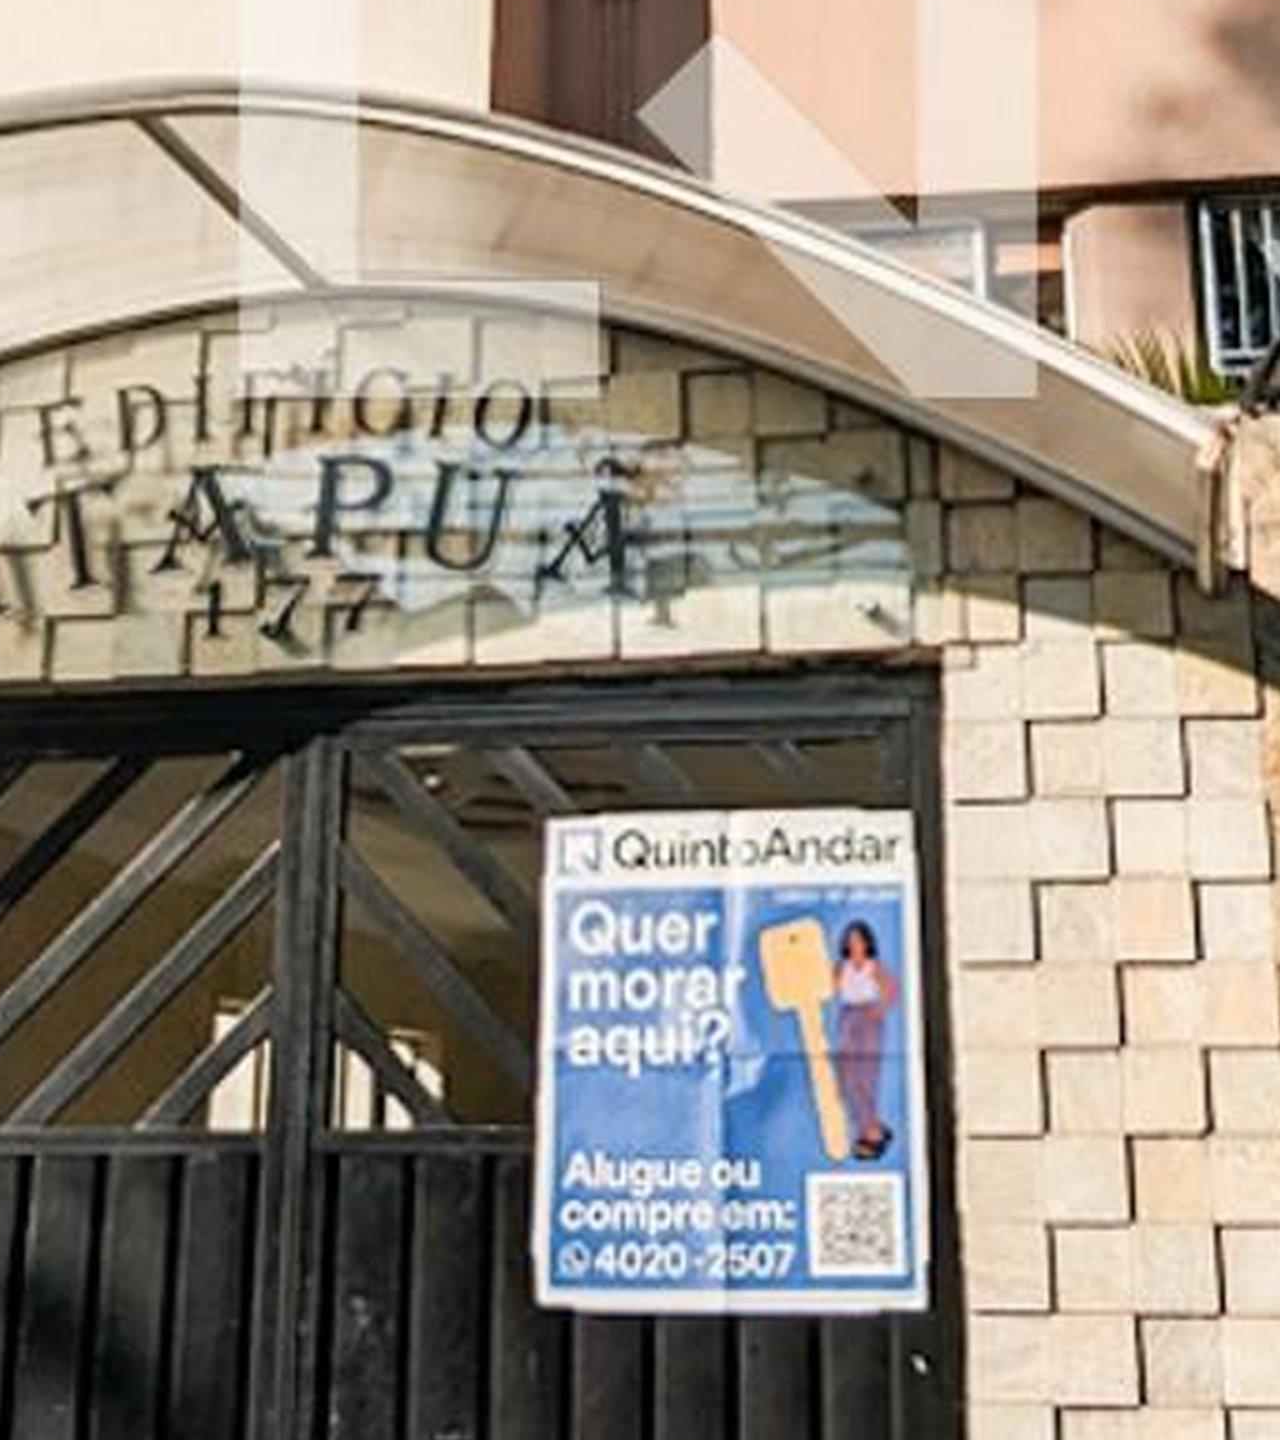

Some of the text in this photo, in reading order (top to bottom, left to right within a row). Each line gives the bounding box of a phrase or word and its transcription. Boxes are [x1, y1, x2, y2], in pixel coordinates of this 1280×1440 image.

[200, 572, 382, 640] 177
[612, 826, 903, 870] QuintoAndar
[569, 900, 719, 958] Quer
[570, 967, 746, 1011] morar
[568, 1012, 732, 1078] aqui?
[561, 1151, 761, 1198] Alugue ou
[559, 1199, 796, 1238] compre em:
